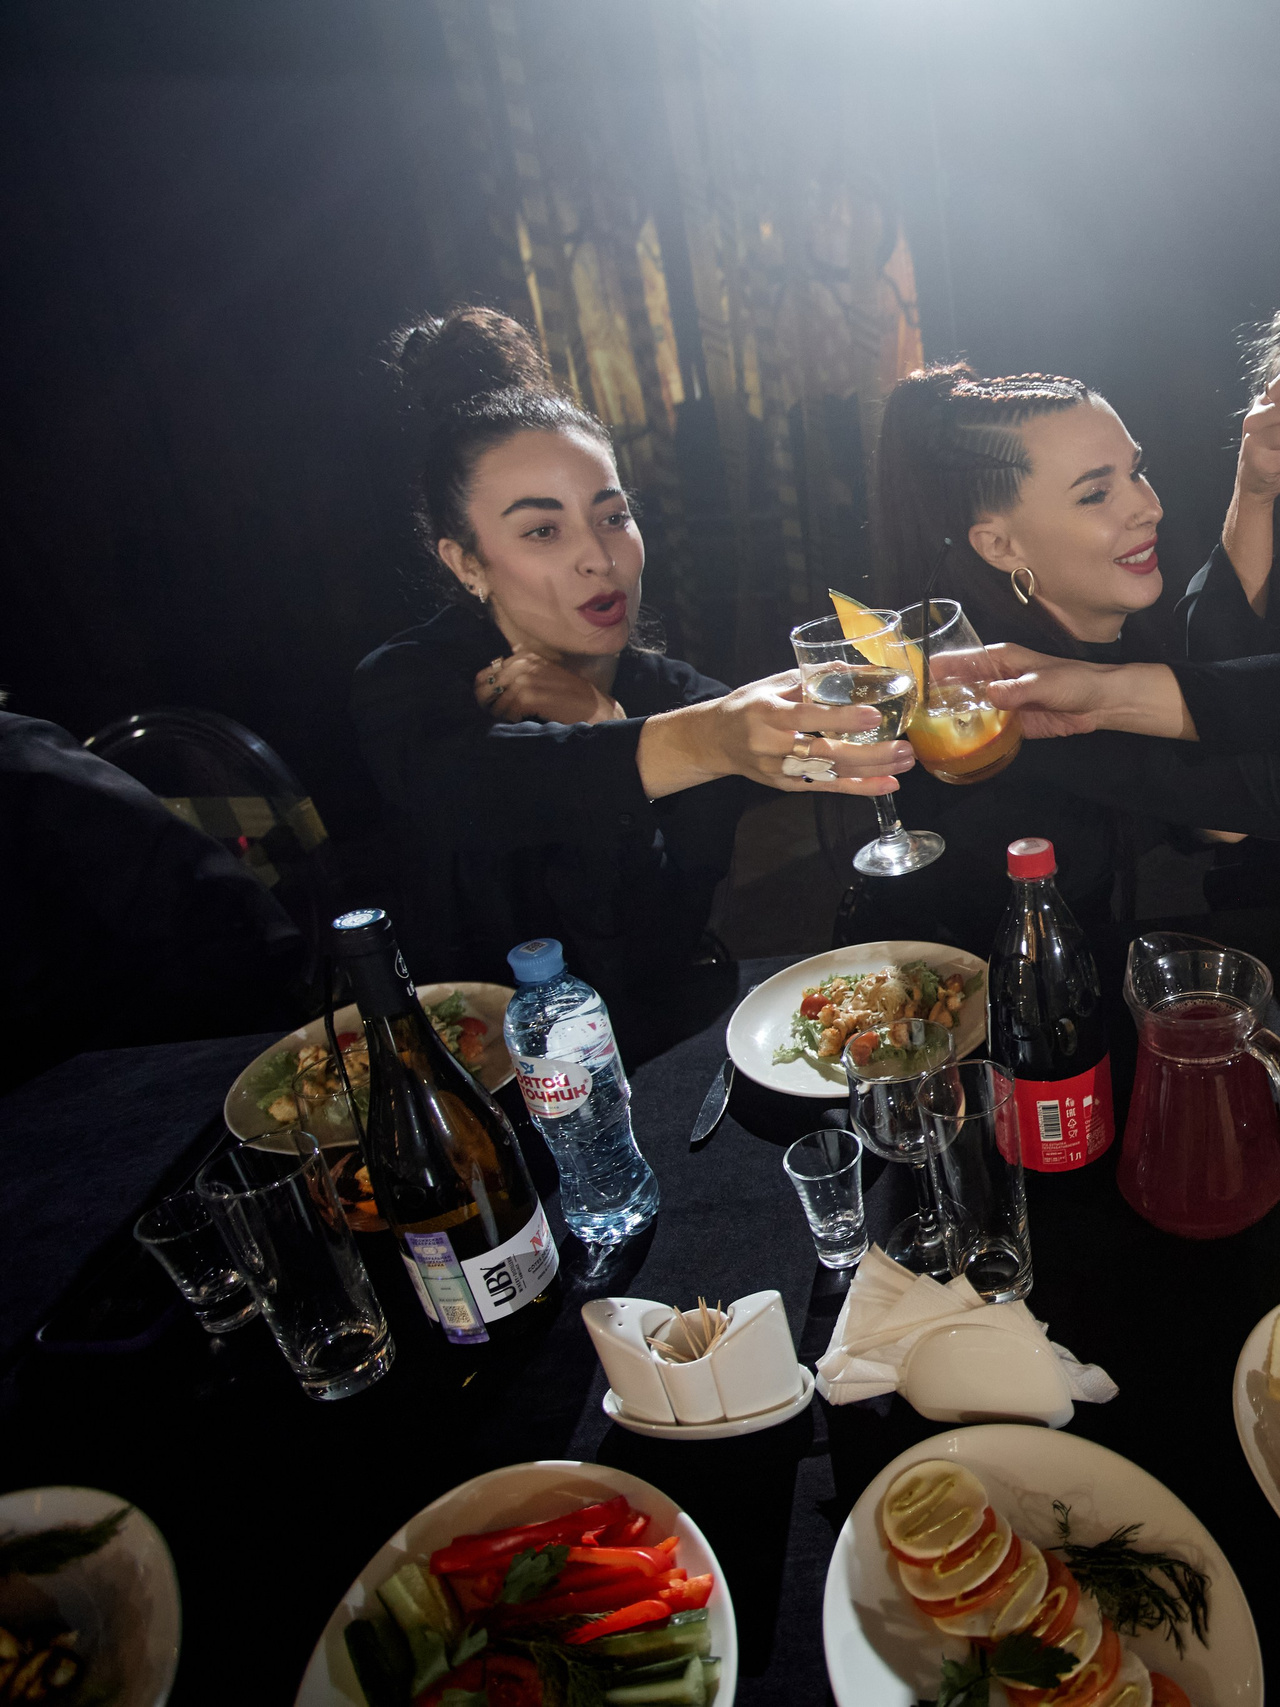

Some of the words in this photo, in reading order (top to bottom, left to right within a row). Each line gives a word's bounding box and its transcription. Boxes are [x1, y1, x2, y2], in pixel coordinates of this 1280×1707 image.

[515, 1067, 570, 1090] ВЯТОЙ
[521, 1084, 588, 1103] ТОЧНИК
[480, 1261, 517, 1307] UBY
